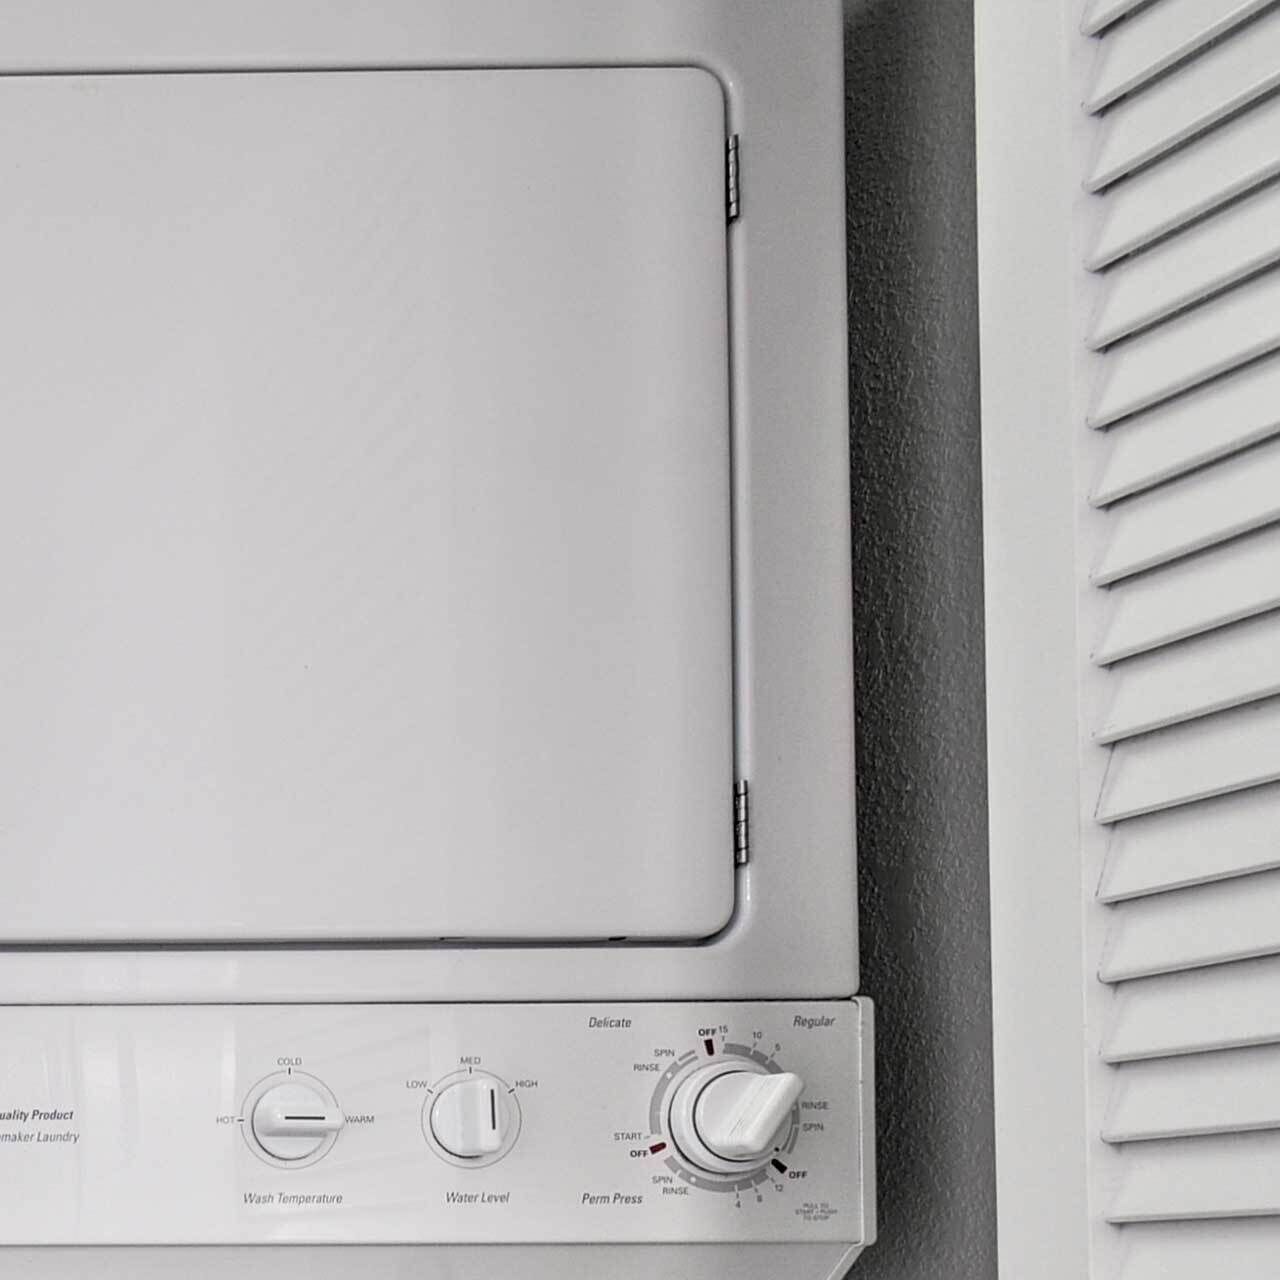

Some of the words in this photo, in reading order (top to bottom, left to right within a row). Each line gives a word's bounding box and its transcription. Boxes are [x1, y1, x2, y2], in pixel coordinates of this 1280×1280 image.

[589, 1016, 632, 1029] Delicate
[793, 1015, 836, 1028] Regular
[698, 1028, 717, 1037] OFF
[718, 1025, 728, 1034] 15
[752, 1031, 762, 1039] 10
[654, 1048, 675, 1057] SPIN
[277, 1057, 302, 1065] COLD
[633, 1063, 660, 1072] RINSE
[801, 1101, 829, 1110] RINSE
[31, 1109, 74, 1120] Product
[216, 1116, 235, 1124] HOT
[345, 1116, 375, 1124] WARM
[802, 1123, 824, 1131] SPIN
[37, 1131, 80, 1144] Laundry
[613, 1133, 642, 1141] START
[630, 1150, 649, 1158] OFF
[652, 1176, 673, 1184] SPIN
[788, 1171, 808, 1180] OFF
[662, 1187, 689, 1195] RINSE
[243, 1193, 274, 1204] Wash
[278, 1192, 343, 1205] Temperature
[446, 1192, 478, 1203] Water
[481, 1192, 510, 1203] Level
[581, 1193, 611, 1206] Perm
[613, 1193, 643, 1205] Press
